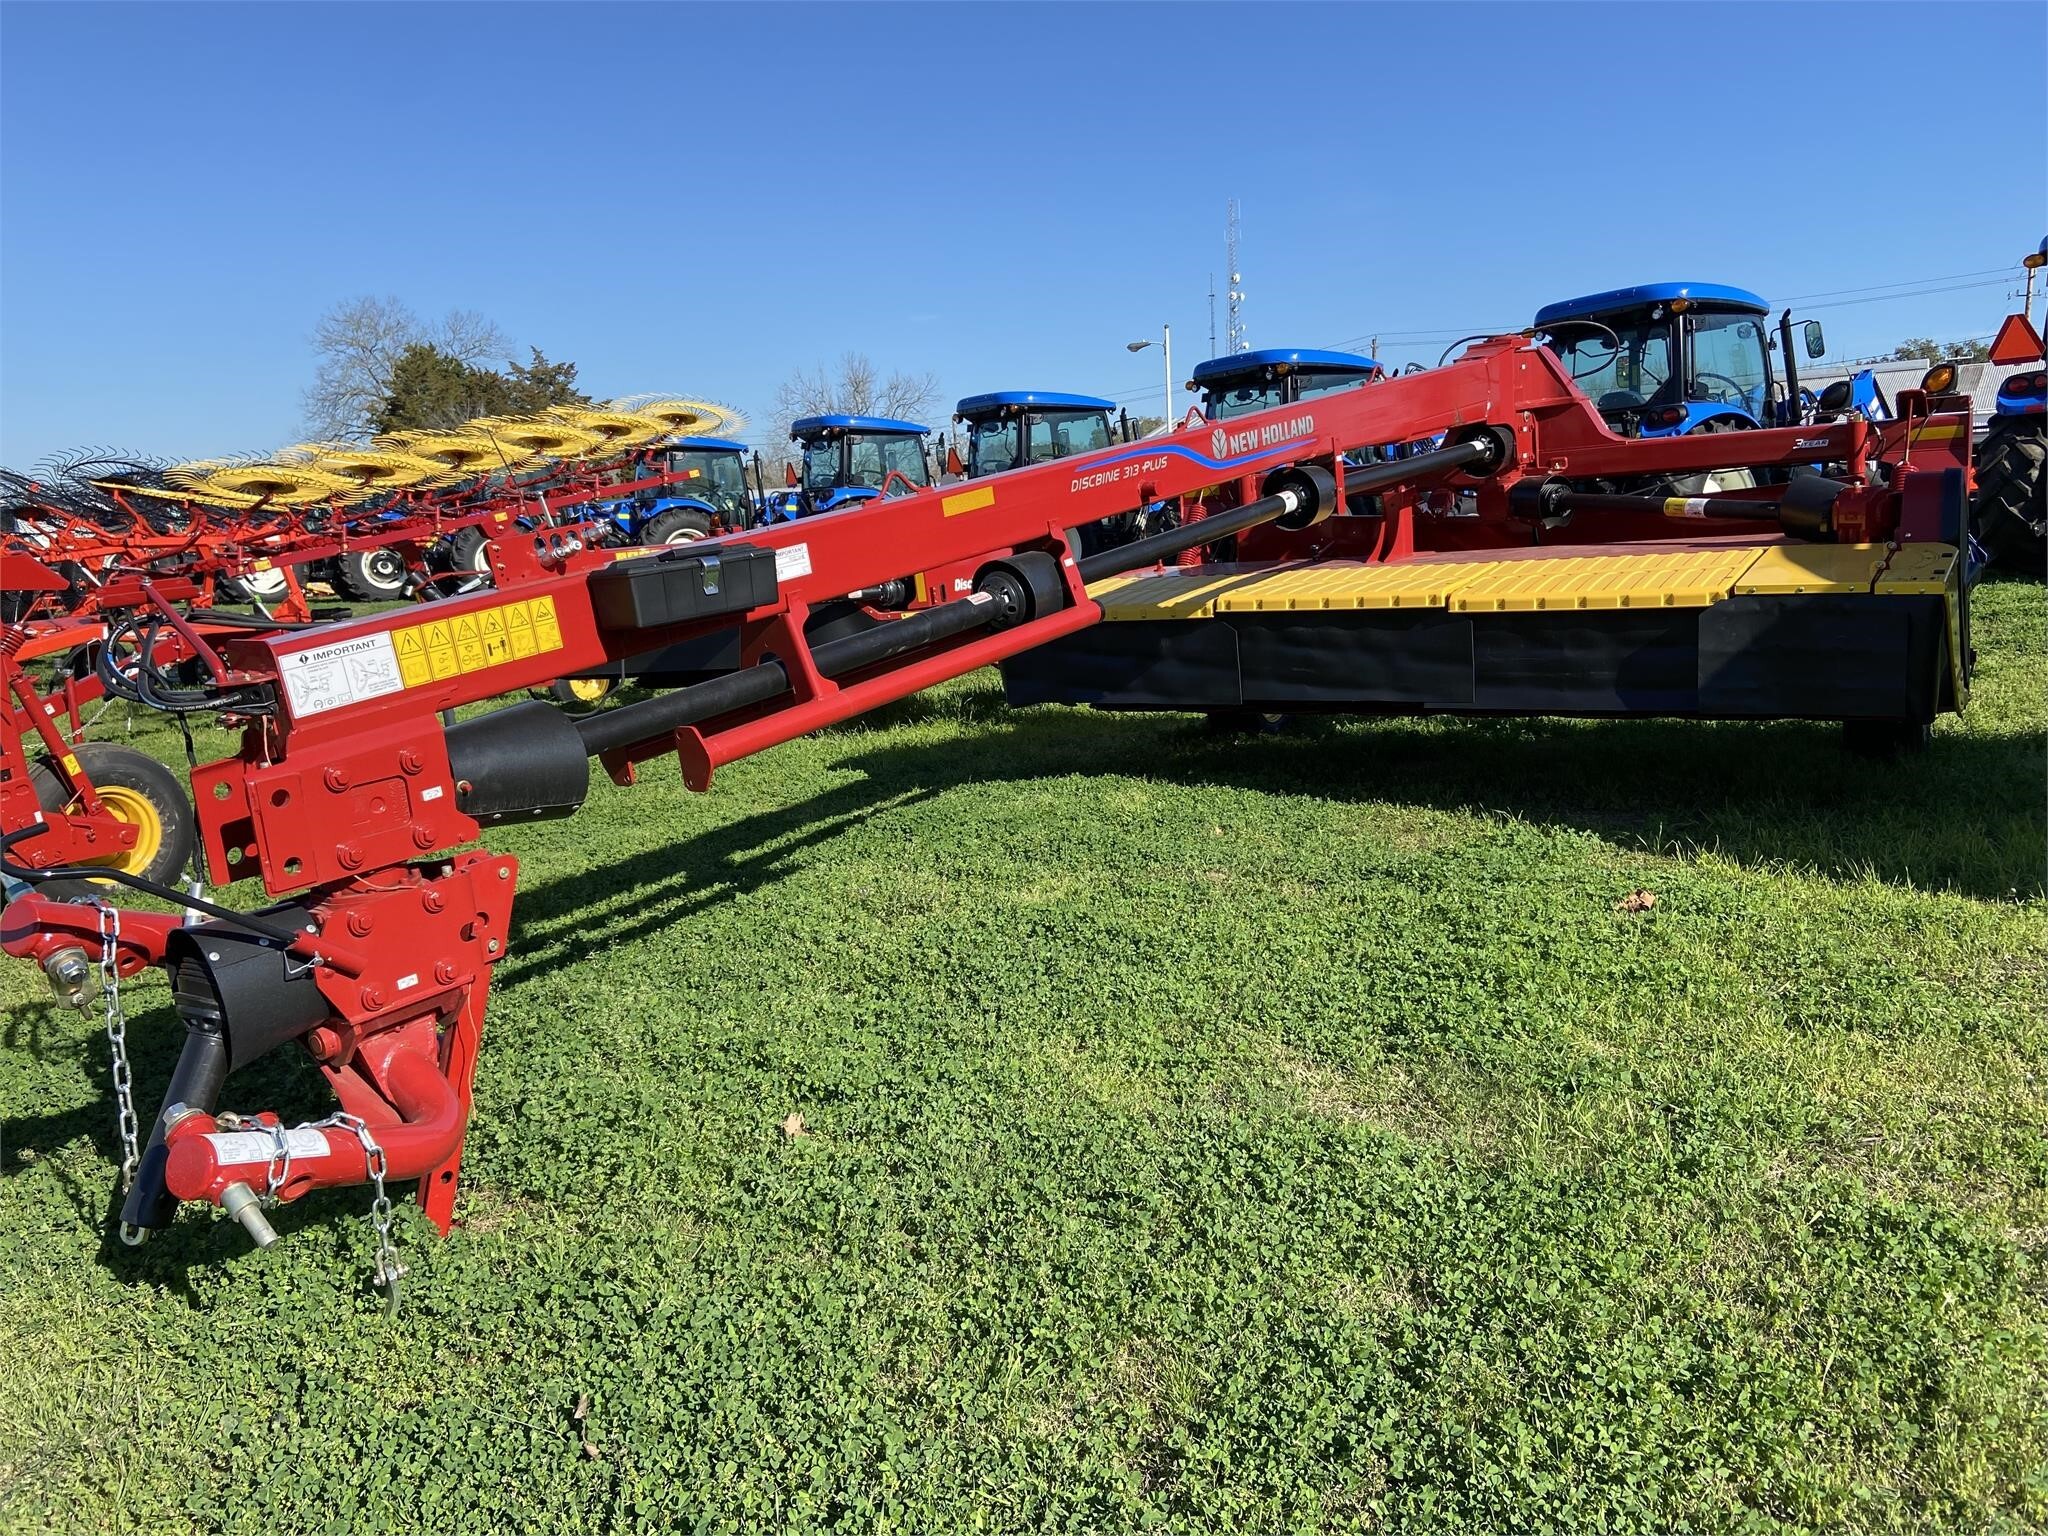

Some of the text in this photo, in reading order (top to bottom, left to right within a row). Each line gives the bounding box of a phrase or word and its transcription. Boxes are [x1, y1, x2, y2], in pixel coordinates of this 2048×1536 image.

[1230, 415, 1314, 455] NEW HOLLAND
[1071, 468, 1120, 493] DISCBINE
[1123, 464, 1139, 479] 313
[313, 639, 376, 661] IMPORTANT
